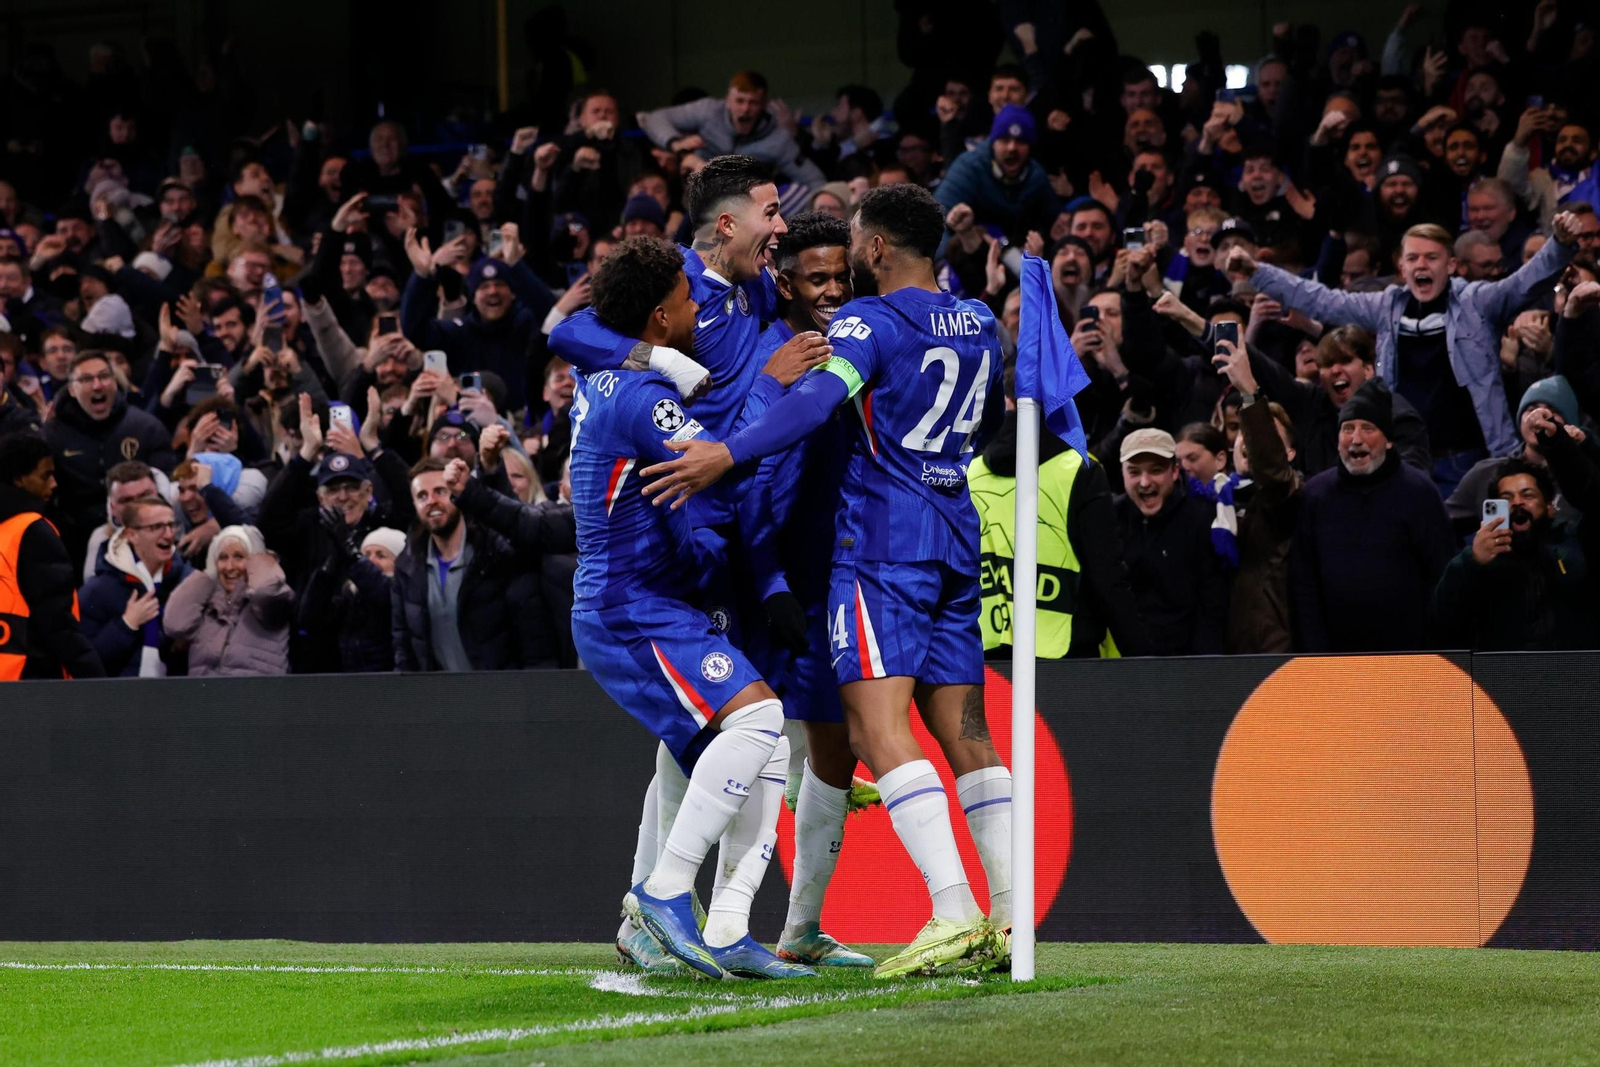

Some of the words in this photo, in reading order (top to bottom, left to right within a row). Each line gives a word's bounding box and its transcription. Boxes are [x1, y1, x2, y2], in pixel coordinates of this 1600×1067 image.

[929, 312, 982, 337] JAMES
[831, 356, 857, 375] ESPECT
[901, 346, 991, 454] 24
[727, 779, 750, 793] CFC
